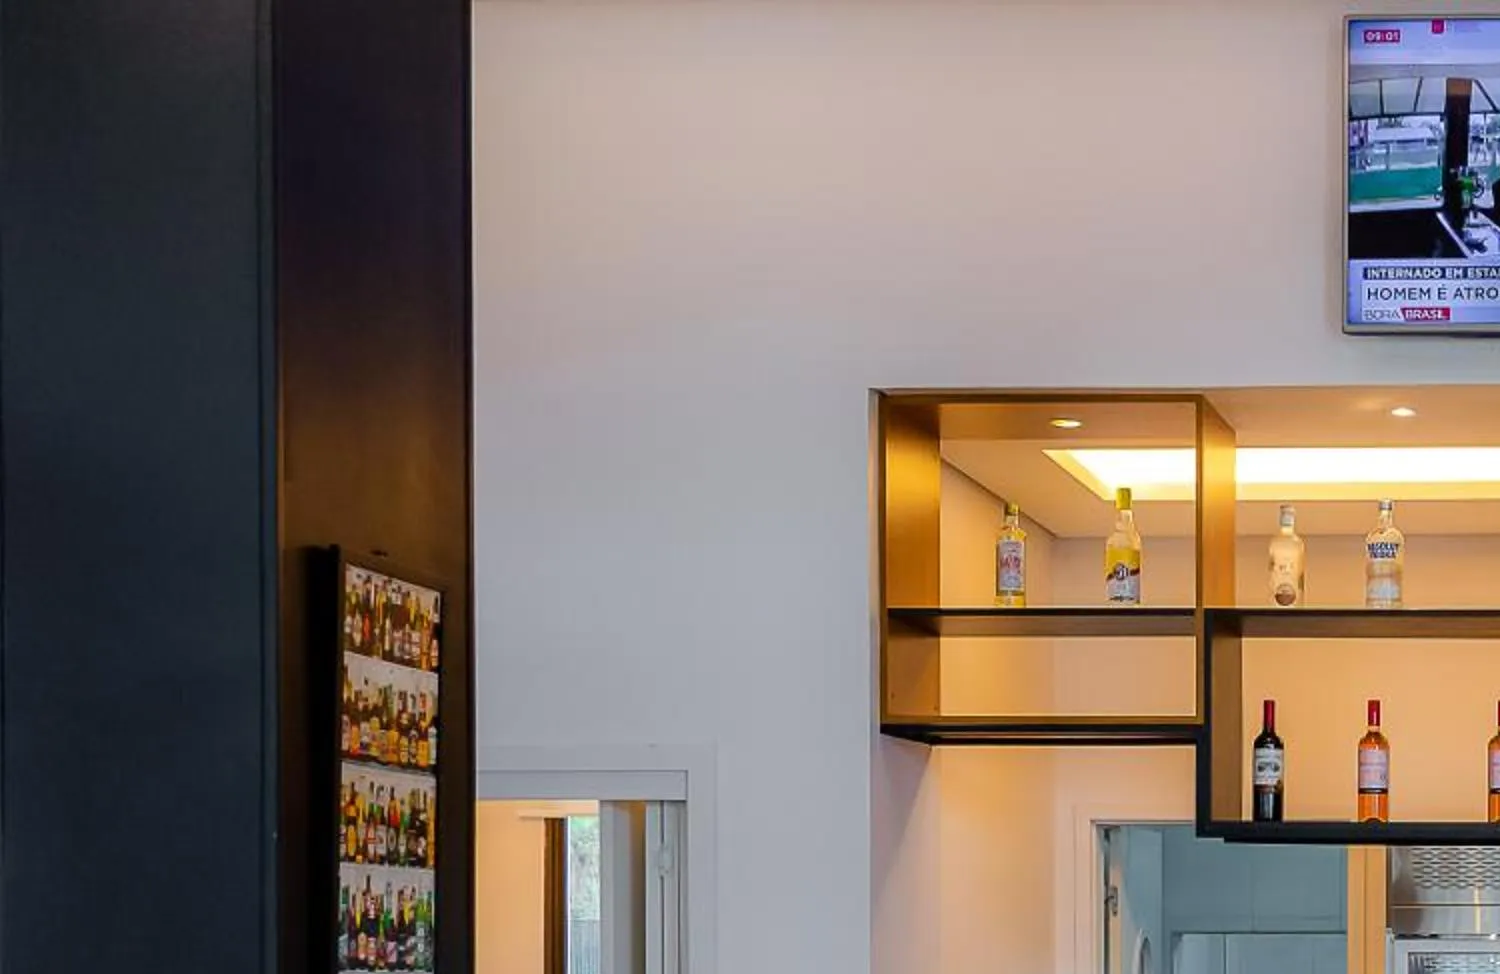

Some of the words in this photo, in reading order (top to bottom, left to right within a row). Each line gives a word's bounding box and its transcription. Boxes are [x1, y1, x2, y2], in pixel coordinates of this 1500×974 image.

[1366, 268, 1442, 279] INTERNADO
[1446, 268, 1464, 279] EM
[1366, 287, 1431, 301] HOMEM
[1437, 284, 1448, 300] É
